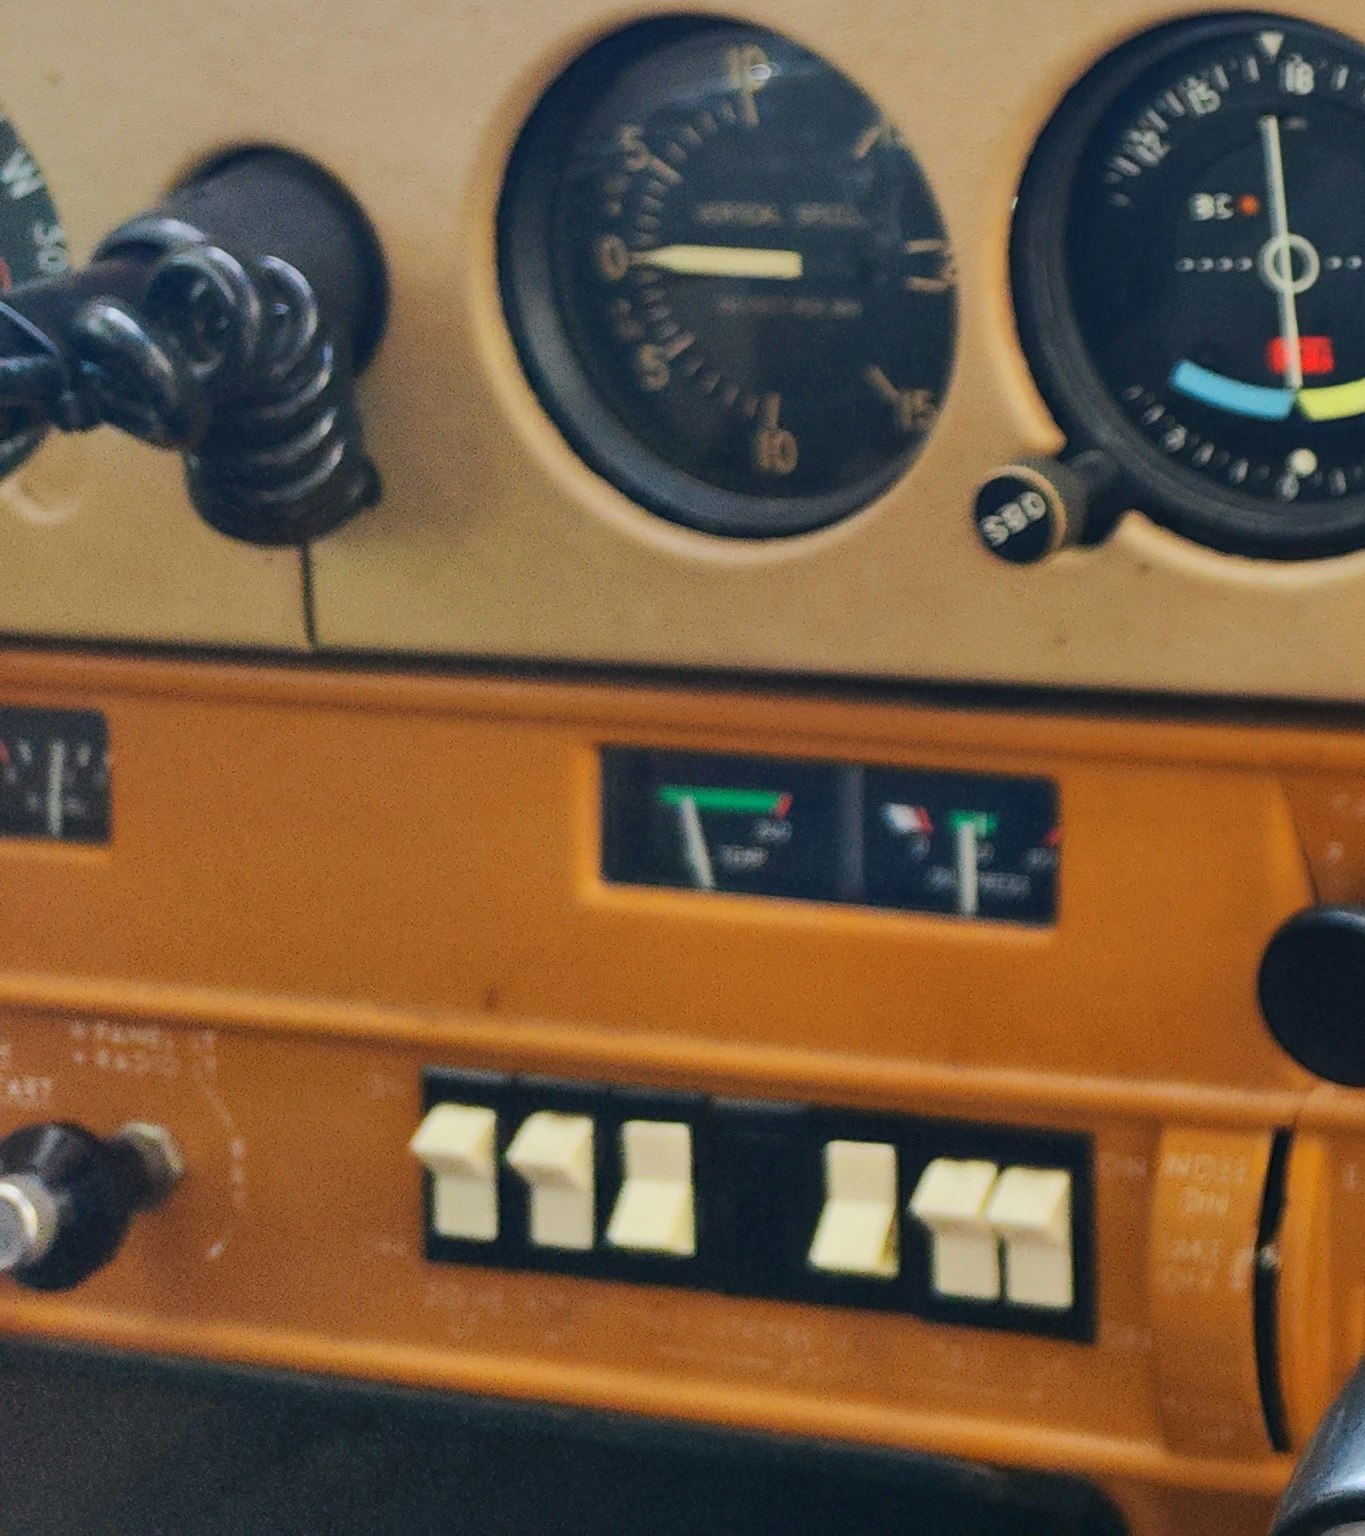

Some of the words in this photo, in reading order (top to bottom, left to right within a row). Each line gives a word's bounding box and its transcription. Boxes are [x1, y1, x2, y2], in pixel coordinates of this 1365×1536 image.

[1282, 60, 1315, 97] 18
[602, 232, 629, 283] 0
[754, 427, 799, 477] 10
